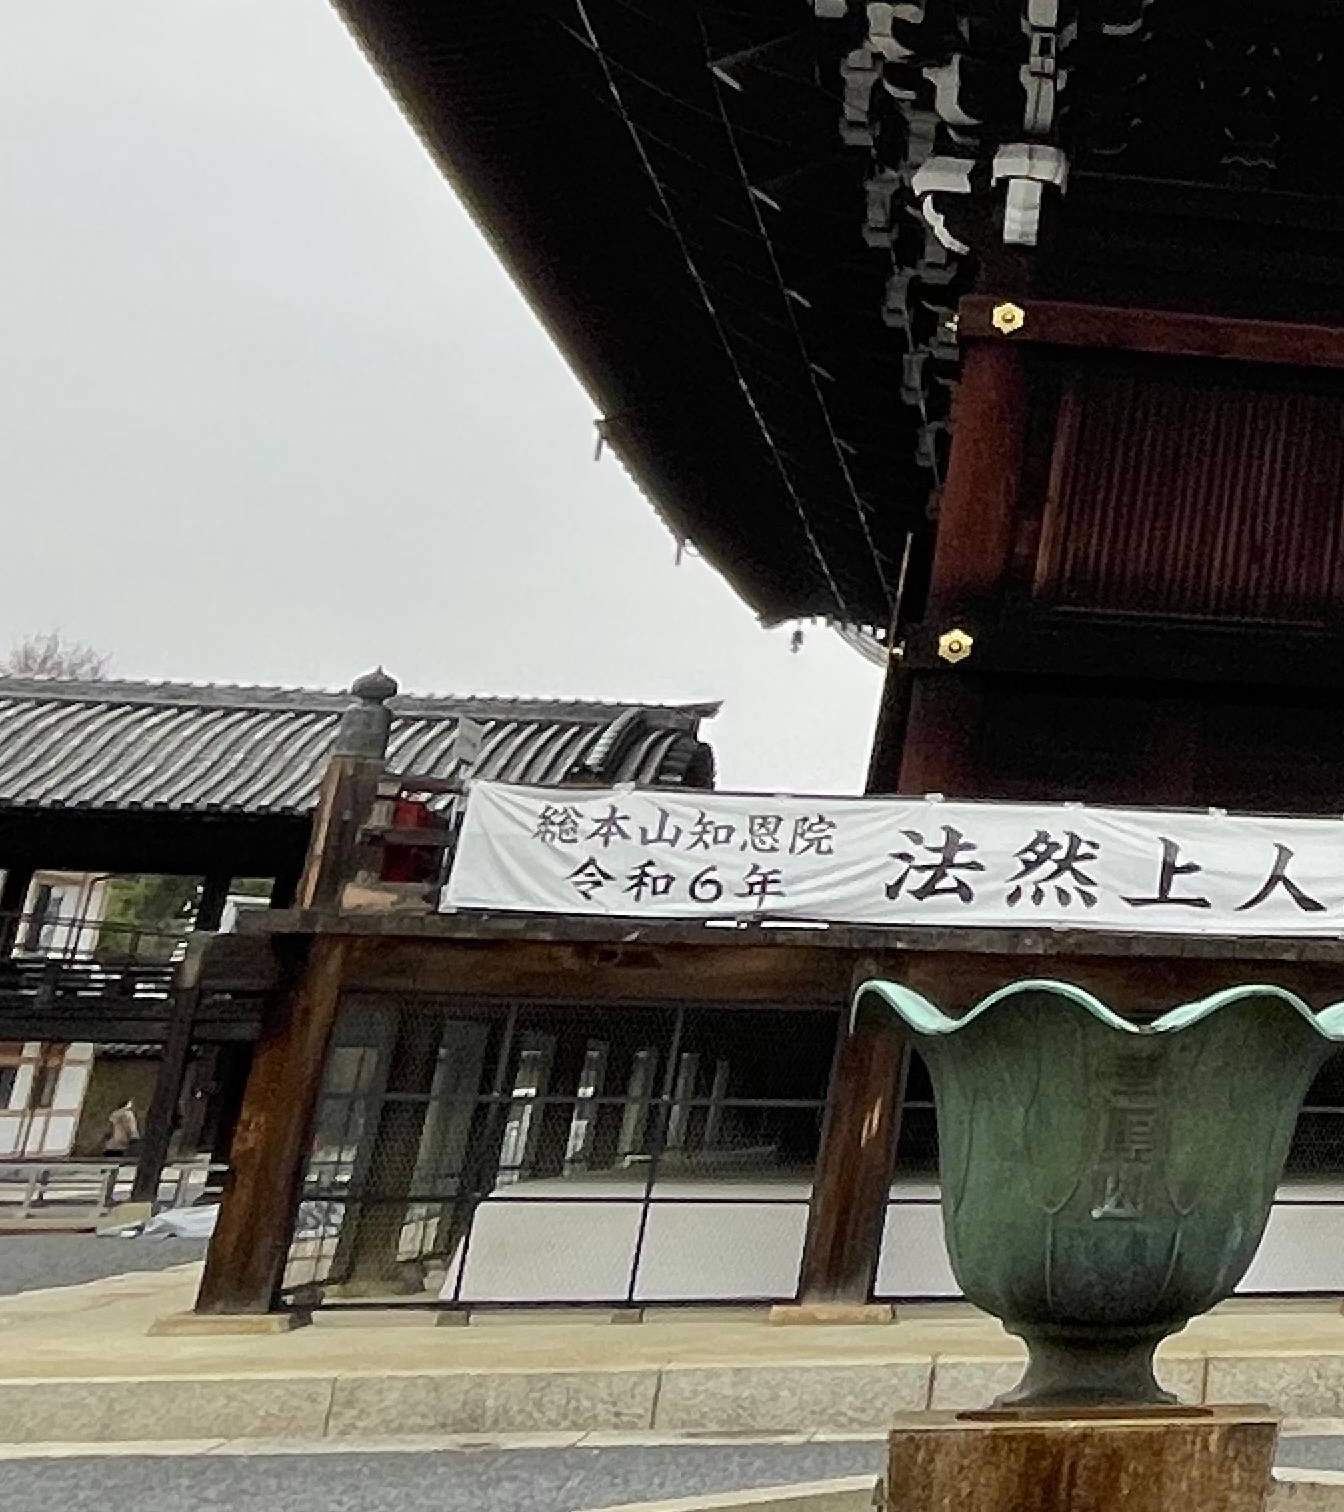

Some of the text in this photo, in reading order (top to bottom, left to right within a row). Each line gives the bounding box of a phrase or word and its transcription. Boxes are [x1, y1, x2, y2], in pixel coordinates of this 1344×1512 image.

[531, 804, 837, 856] 総本山知恩院
[567, 857, 787, 908] 令和6年
